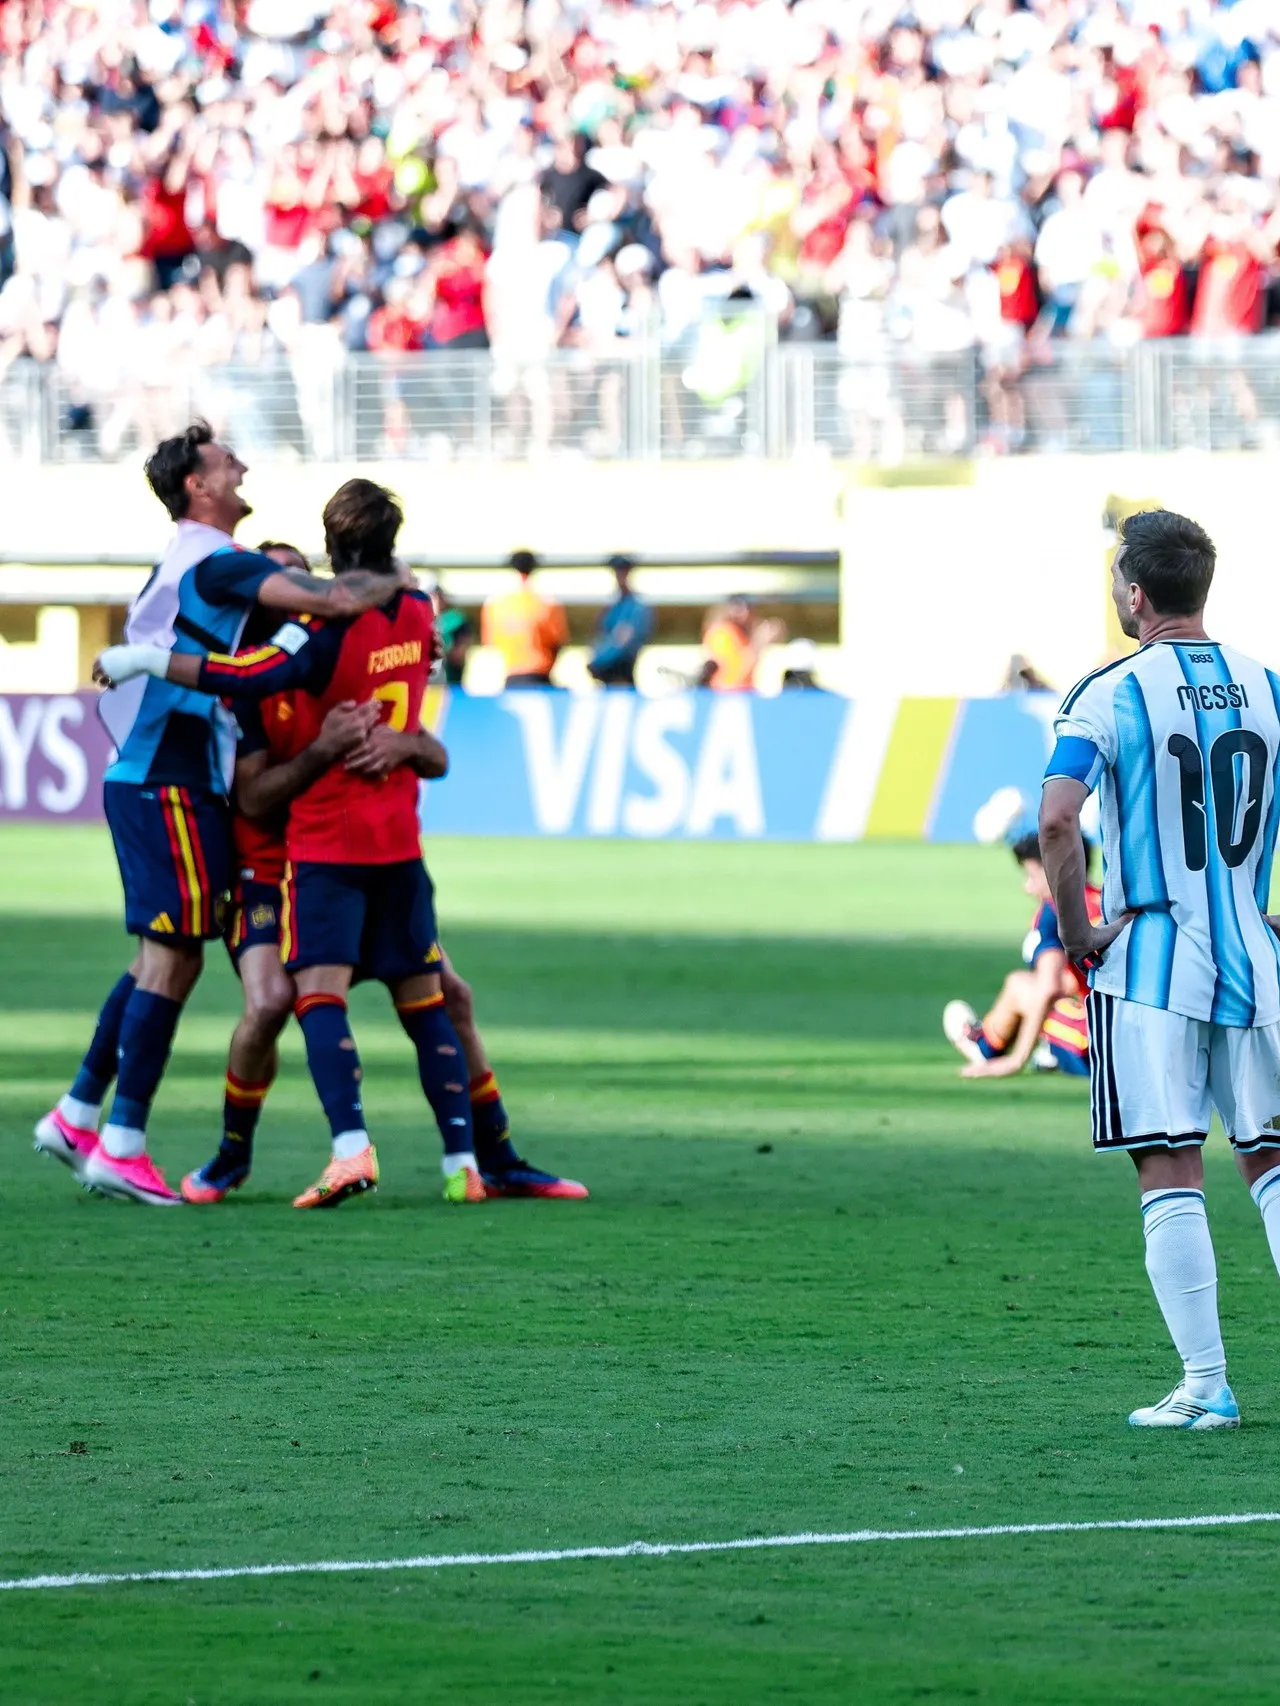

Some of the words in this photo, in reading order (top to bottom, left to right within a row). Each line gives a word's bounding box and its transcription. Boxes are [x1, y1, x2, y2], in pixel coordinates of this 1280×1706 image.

[1177, 684, 1249, 710] MESSI
[1187, 653, 1214, 663] 1893
[0, 696, 87, 812] YS
[502, 691, 765, 836] VISA
[1168, 728, 1268, 871] 10
